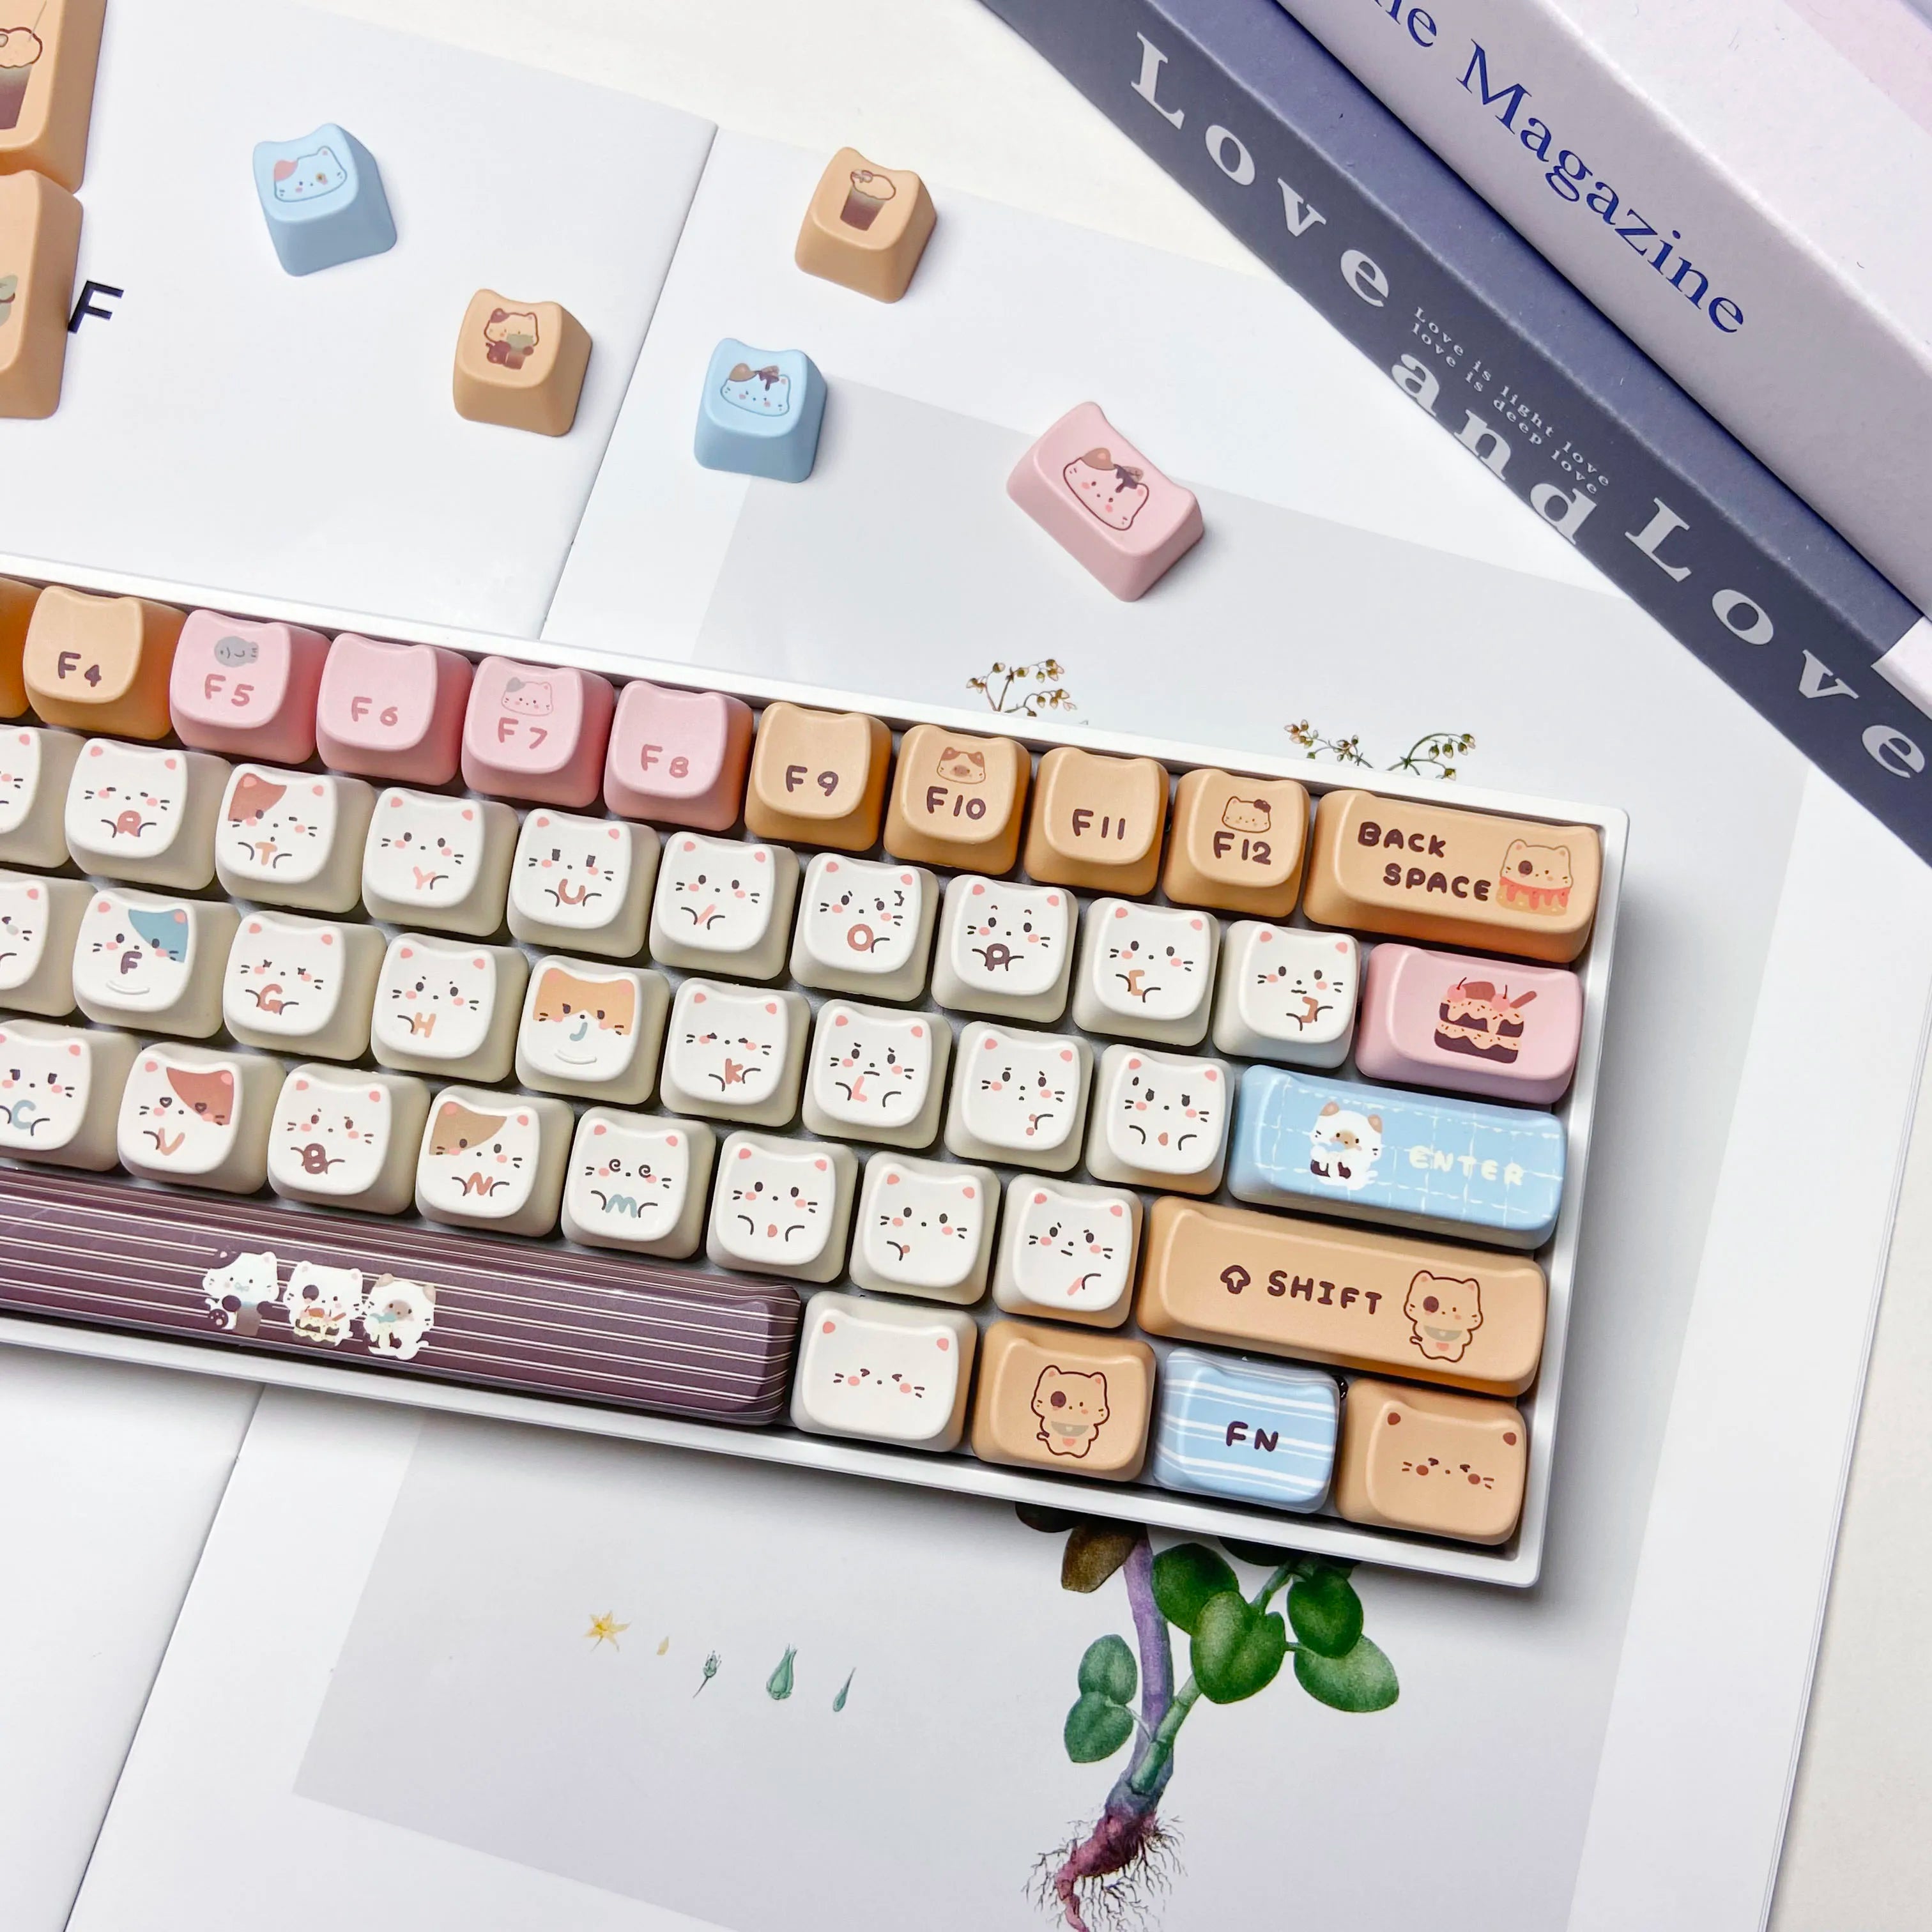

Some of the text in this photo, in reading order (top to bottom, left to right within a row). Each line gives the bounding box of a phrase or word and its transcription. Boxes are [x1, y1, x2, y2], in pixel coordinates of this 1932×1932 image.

[1456, 39, 1744, 333] Magazine
[1130, 32, 1924, 778] Love and Love
[1412, 323, 1597, 494] love is deep love
[1414, 307, 1609, 486] Love is light love
[57, 651, 102, 687] F4
[204, 673, 254, 707] F5
[351, 696, 398, 726] F6
[498, 717, 548, 749] F7
[641, 744, 689, 778] F8
[786, 765, 839, 796] F9
[926, 786, 986, 820] F10
[255, 841, 277, 866] T
[1214, 831, 1271, 865] F12
[1358, 822, 1446, 857] BACK
[1383, 863, 1491, 901] SPACE
[120, 951, 142, 974] F
[413, 1013, 436, 1038] H
[724, 1058, 744, 1085] K
[1409, 1145, 1524, 1186] ENTER
[1268, 1269, 1382, 1314] SHIFT
[1226, 1420, 1278, 1452] FN
